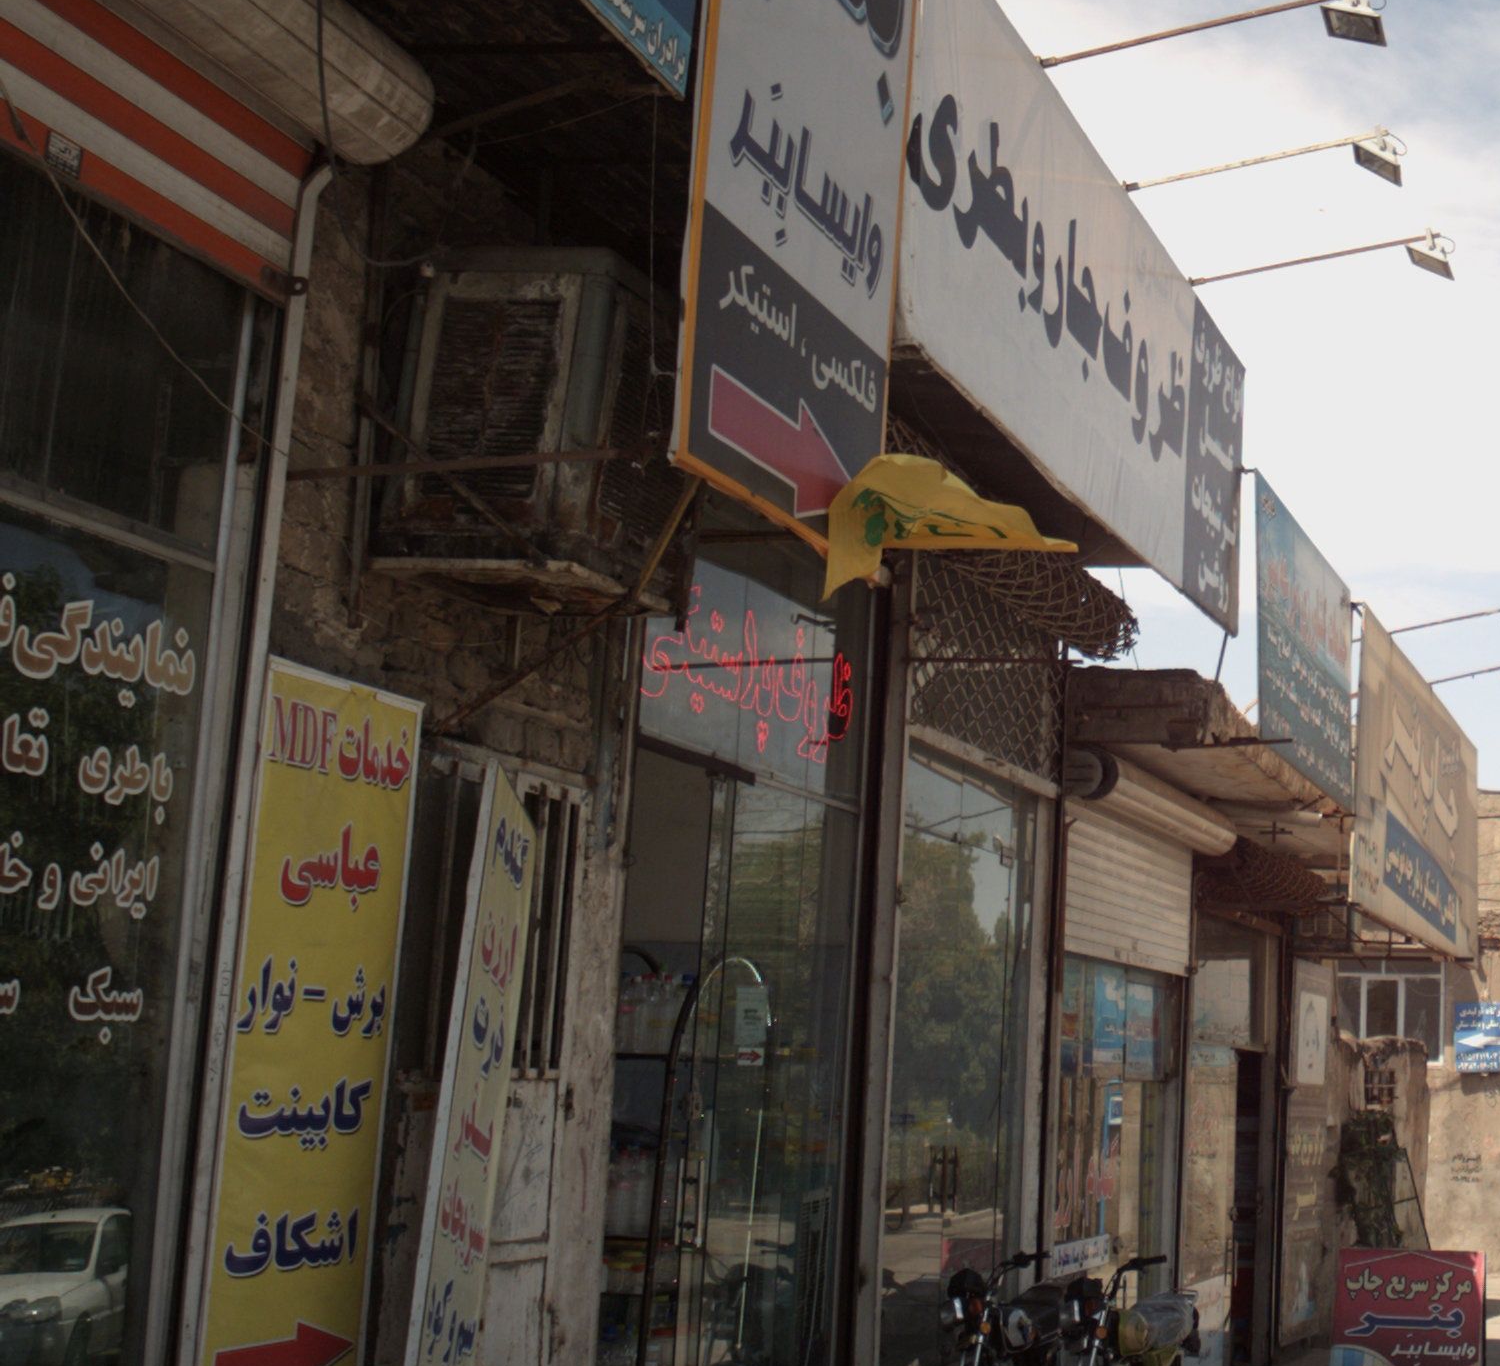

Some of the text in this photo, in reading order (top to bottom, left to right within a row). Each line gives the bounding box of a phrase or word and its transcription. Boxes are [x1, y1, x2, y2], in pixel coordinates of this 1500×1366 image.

[719, 265, 798, 349] استیکر
[1101, 290, 1186, 462] ظروف
[13, 599, 195, 707] نمایندگی
[2, 707, 173, 825] باطری تعا
[267, 695, 412, 790] خدمات MDF
[38, 863, 61, 910] و
[70, 842, 159, 918] ایرانی
[281, 823, 380, 911] عباسی
[68, 967, 143, 1045] سبک
[237, 955, 297, 1034] نوار
[332, 967, 387, 1036] برش
[237, 1078, 373, 1151] کابینت
[225, 1207, 359, 1277] اشکاف
[1344, 1304, 1465, 1338] بنر
[1346, 1267, 1472, 1301] مرکز سریع چاپ
